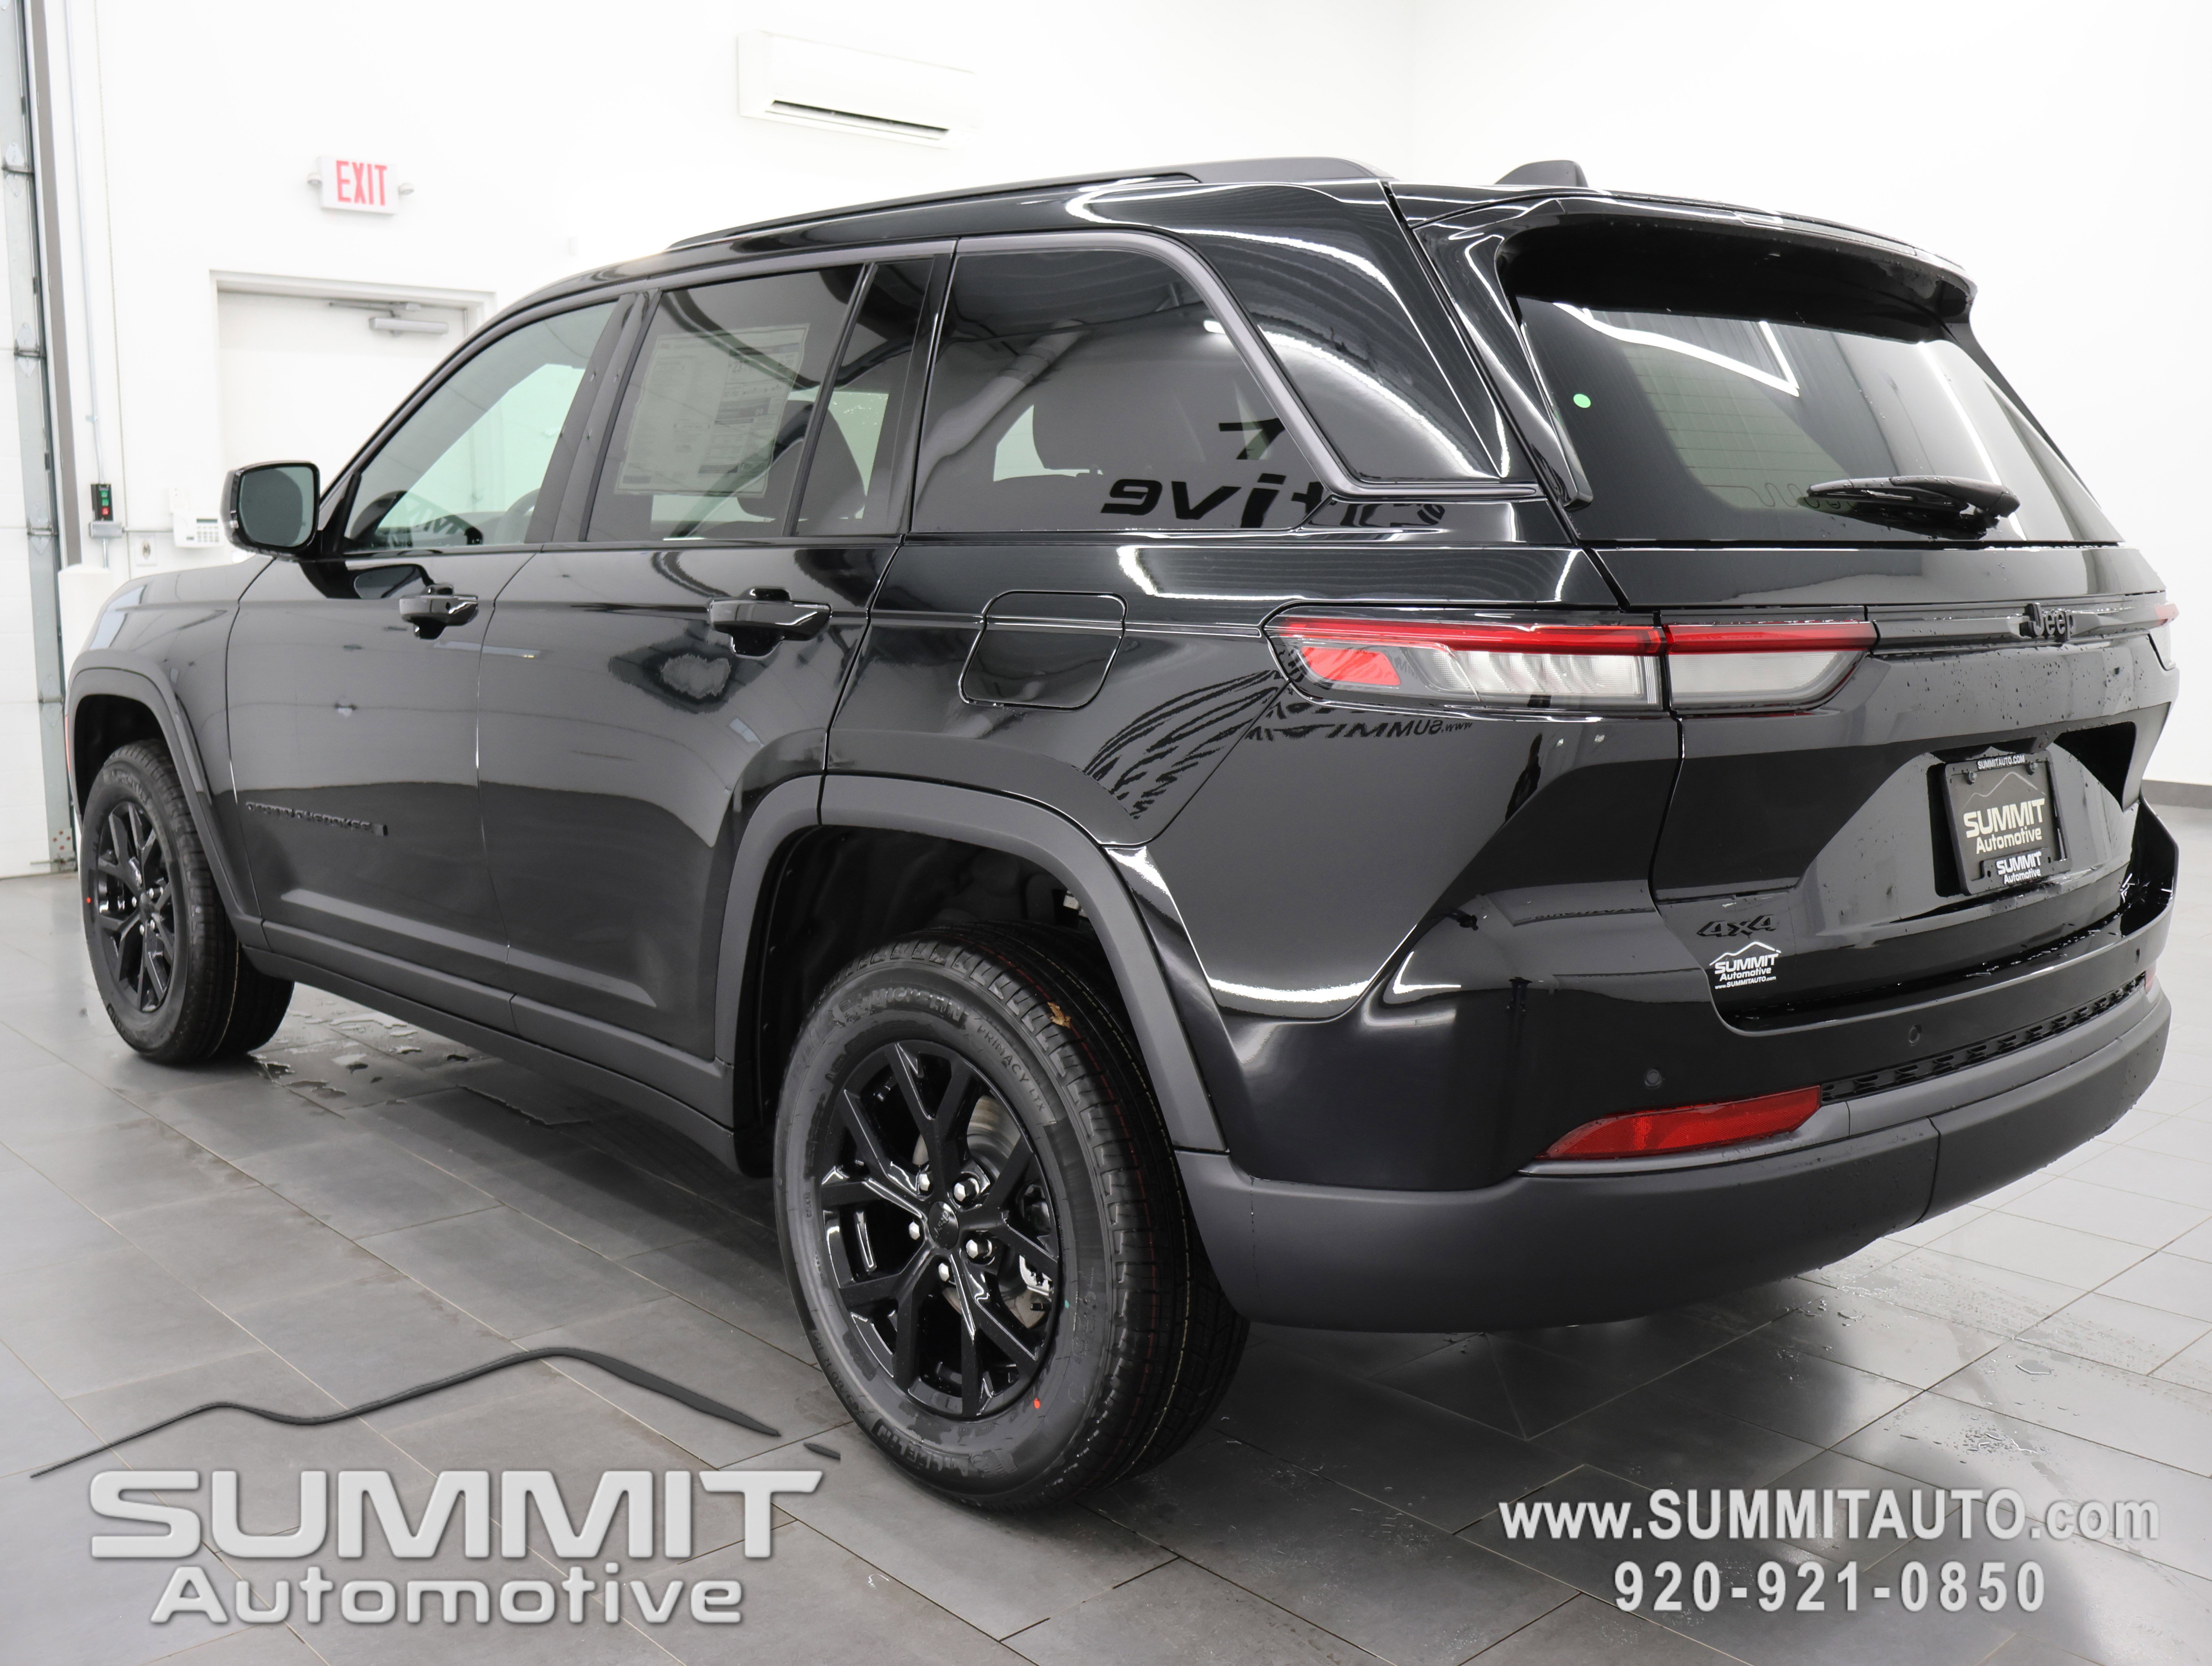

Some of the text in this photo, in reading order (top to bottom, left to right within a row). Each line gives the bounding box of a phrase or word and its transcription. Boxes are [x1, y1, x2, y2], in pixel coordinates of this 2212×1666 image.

[336, 159, 388, 206] EXIT
[2026, 602, 2076, 642] Jeep
[1977, 754, 2025, 770] SUMMITAUTO.COM
[1963, 798, 2045, 838] SUMMIT
[1976, 826, 2042, 855] Automotive
[1996, 851, 2042, 875] SUMMIT
[2004, 868, 2042, 885] Automotive
[1714, 953, 1779, 975] SUMMIT
[1719, 967, 1772, 982] Automotive
[1714, 976, 1777, 990] www.SUMMITAUTO.com
[977, 1025, 1029, 1082] PRIMACY
